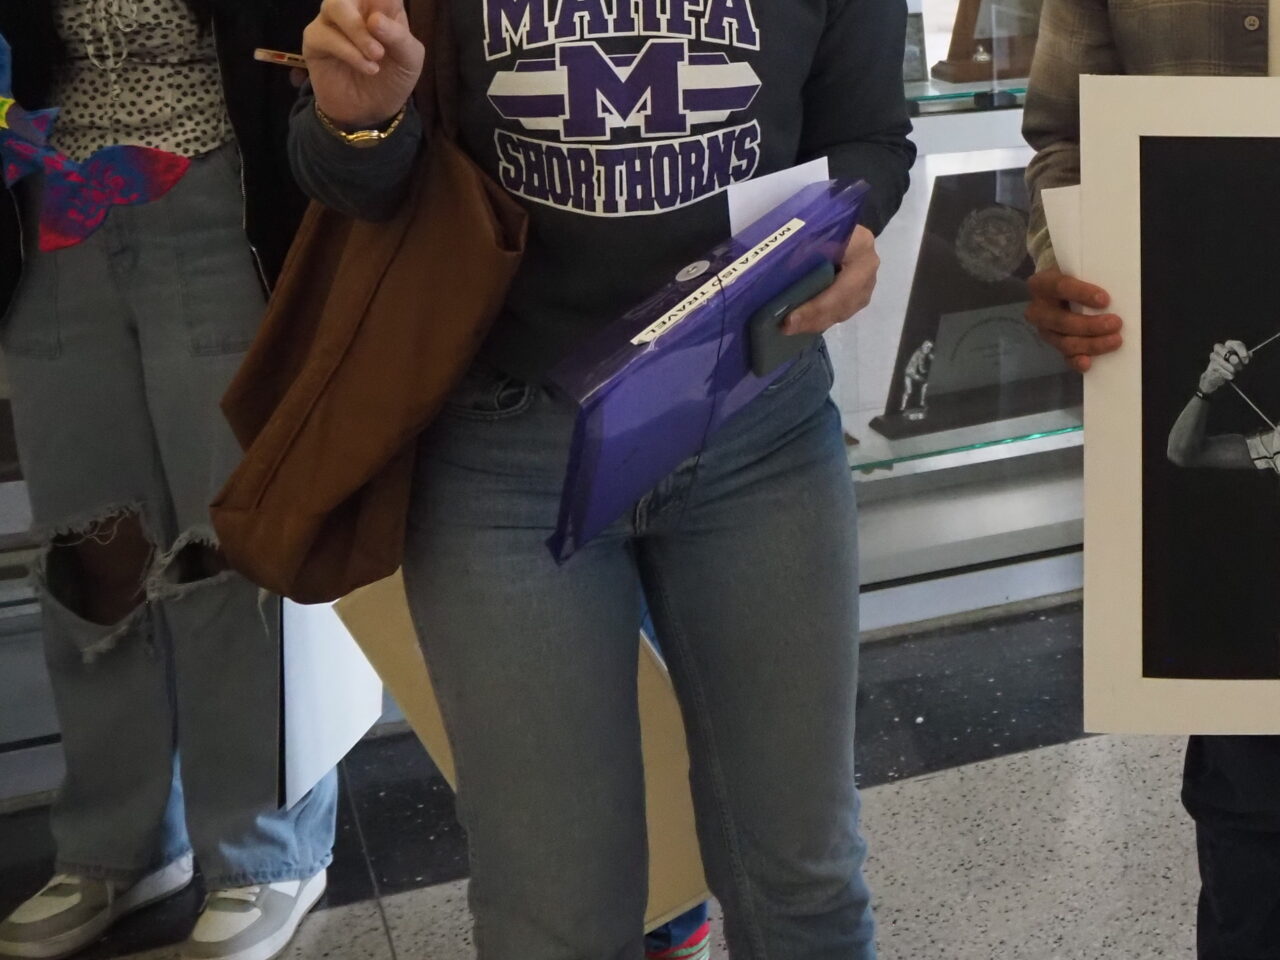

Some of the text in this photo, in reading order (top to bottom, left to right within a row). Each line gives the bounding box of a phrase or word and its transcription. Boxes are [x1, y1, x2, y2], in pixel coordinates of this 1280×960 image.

[555, 39, 689, 142] M
[494, 119, 761, 217] SHORTHORNS
[644, 227, 792, 336] MARFA ISD TRAVEL
